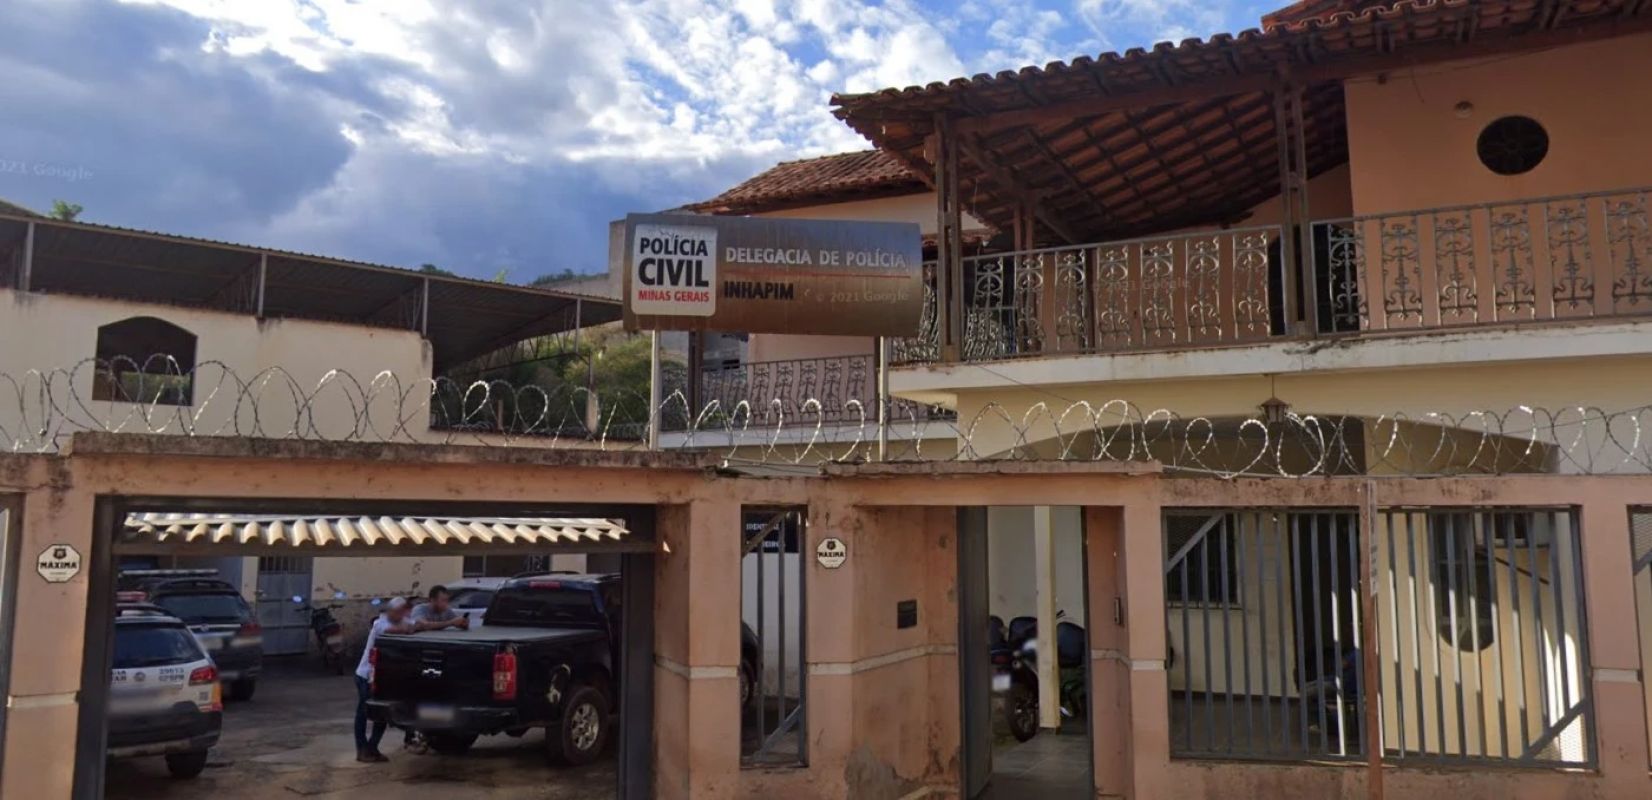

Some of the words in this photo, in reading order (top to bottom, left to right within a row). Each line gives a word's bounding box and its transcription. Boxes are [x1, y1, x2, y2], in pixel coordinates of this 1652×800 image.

[640, 235, 708, 256] POLÍCIA
[725, 247, 812, 264] DELEGACIA
[819, 250, 839, 265] DE
[846, 248, 907, 268] POLÍCIA
[638, 258, 709, 287] CIVIL
[638, 290, 671, 301] MINAS
[674, 291, 709, 303] GERAIS
[724, 281, 794, 300] INHAPIM
